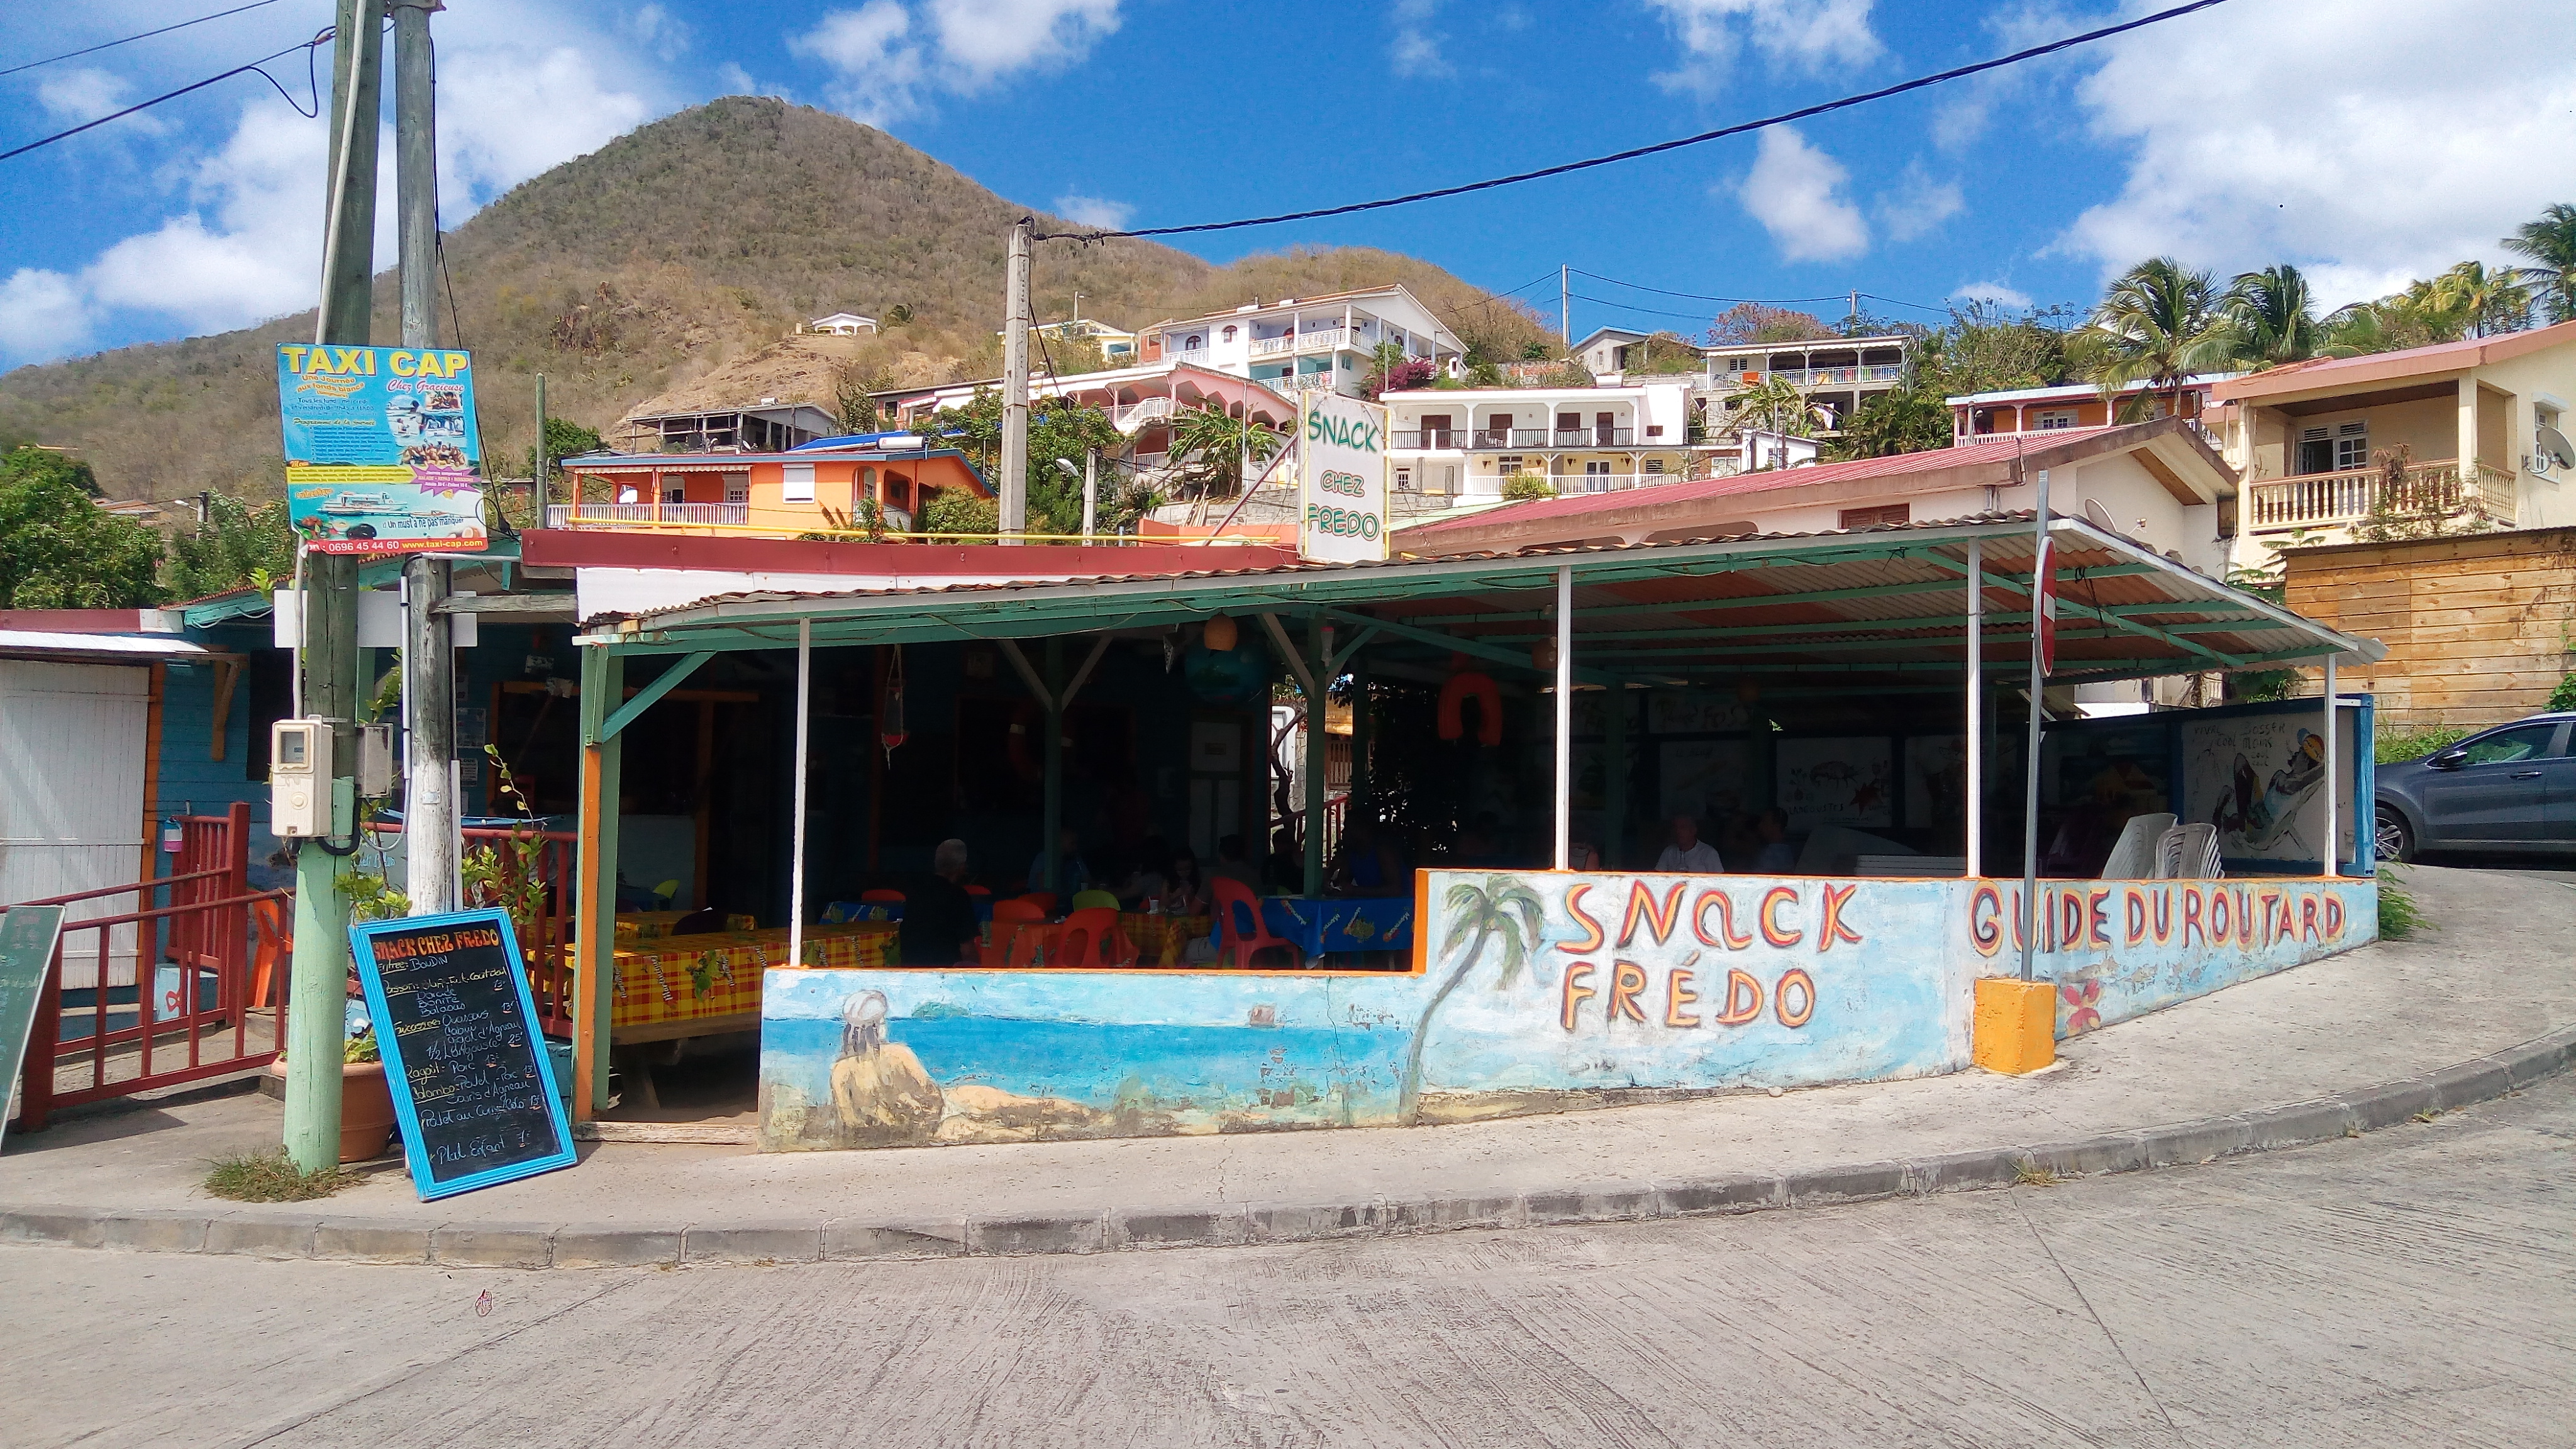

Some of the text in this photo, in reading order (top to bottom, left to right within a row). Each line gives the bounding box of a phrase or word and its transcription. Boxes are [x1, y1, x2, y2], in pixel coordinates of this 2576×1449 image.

[280, 347, 469, 379] TAXI CAP
[386, 379, 465, 392] Chez Gracieuse
[1308, 410, 1379, 453] SNACK
[1321, 470, 1365, 497] CHEZ
[1307, 503, 1380, 541] FREDO
[329, 543, 354, 552] 0696
[357, 542, 369, 550] 45
[372, 541, 384, 550] 44
[386, 541, 399, 549] 60
[401, 540, 484, 549] www.taxi-cap.com
[1969, 881, 2347, 957] GUIDE DU ROUTARD
[373, 928, 500, 960] SNACK CHEZ FREDO
[1560, 951, 1816, 1033] FRÉDO
